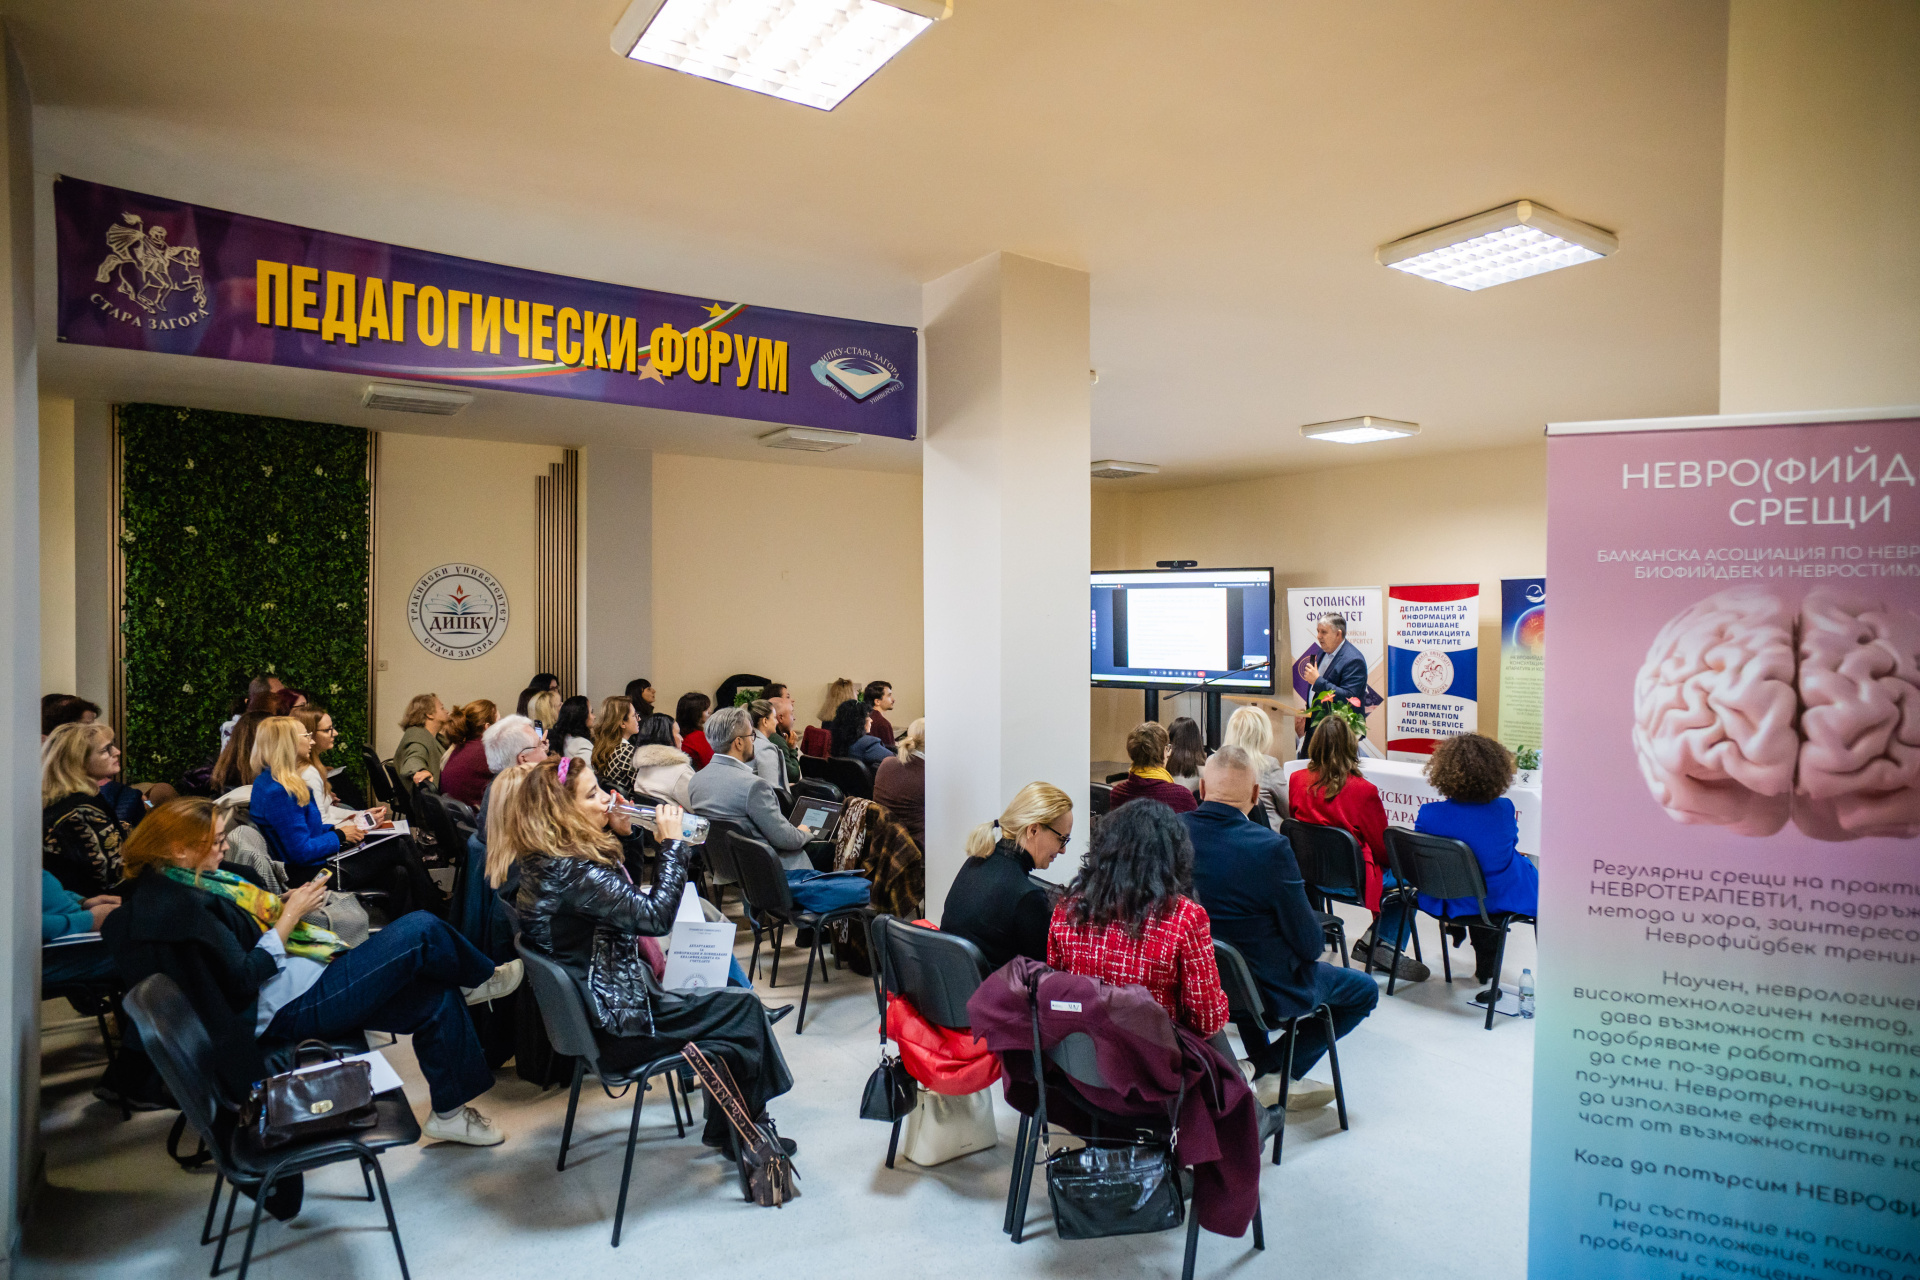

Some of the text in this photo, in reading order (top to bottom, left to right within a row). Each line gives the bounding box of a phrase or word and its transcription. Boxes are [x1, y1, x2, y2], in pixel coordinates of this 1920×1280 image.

[90, 293, 210, 330] СТАРА ЗАГОРА
[256, 259, 788, 392] ПЕДАГОГИЧЕСКИ ФОРУМ
[873, 352, 900, 380] ЗАГОРА
[1729, 495, 1891, 530] СРЕЩИ
[1597, 544, 1920, 563] БАЛКАНСКА АСОЦИАЦИЯ ПО НЕВР
[1635, 562, 1764, 580] БИОФИЙДБЕК
[1769, 564, 1783, 578] И
[411, 566, 507, 623] ТРАКИЙСКИ УНИВЕРСИТЕТ
[1304, 596, 1365, 607] СТОПАНСКИ
[429, 616, 494, 633] ДИПКУ
[1306, 611, 1363, 622] ФАТЕТ
[424, 637, 494, 658] СТАРА ЗАГОРА
[1402, 702, 1452, 711] DEPARTMENT
[1406, 711, 1459, 720] INFORMATION
[1419, 720, 1464, 728] IN-SERVICE
[1397, 726, 1430, 734] TEACHER
[1593, 859, 1703, 881] Регулярни
[1710, 870, 1786, 888] срещи
[1793, 876, 1824, 889] на
[1590, 880, 1920, 919] НЕВРОТЕРАПЕВТИ, поддръж
[1588, 905, 1920, 942] метода и хора, заинтересо
[1645, 926, 1817, 956] Неврофийдбек
[1573, 987, 1812, 1022] високотехнологичен
[1662, 970, 1920, 1011] Научен, неврологиче
[1600, 1011, 1652, 1026] дава
[1659, 1016, 1805, 1042] възможност
[1573, 1028, 1721, 1055] подобряваме
[1727, 1045, 1861, 1072] работата
[1869, 1063, 1901, 1078] на
[1589, 1051, 1616, 1066] да
[1621, 1054, 1662, 1069] сме
[1668, 1059, 1793, 1087] по-здрави,
[1576, 1070, 1669, 1092] по-умни.
[1675, 1078, 1897, 1122] Невротренингът
[1579, 1091, 1605, 1106] да
[1611, 1094, 1743, 1123] използваме
[1749, 1112, 1891, 1144] ефективно
[1578, 1111, 1634, 1128] част
[1640, 1119, 1672, 1133] от
[1679, 1124, 1885, 1166] възможностите
[1574, 1148, 1624, 1168] Кога
[1630, 1160, 1657, 1175] да
[1664, 1164, 1787, 1193] потърсим
[1598, 1192, 1920, 1265] При състояние на психол
[1613, 1219, 1816, 1269] неразположение,
[1580, 1233, 1821, 1280] проблеми с концен
